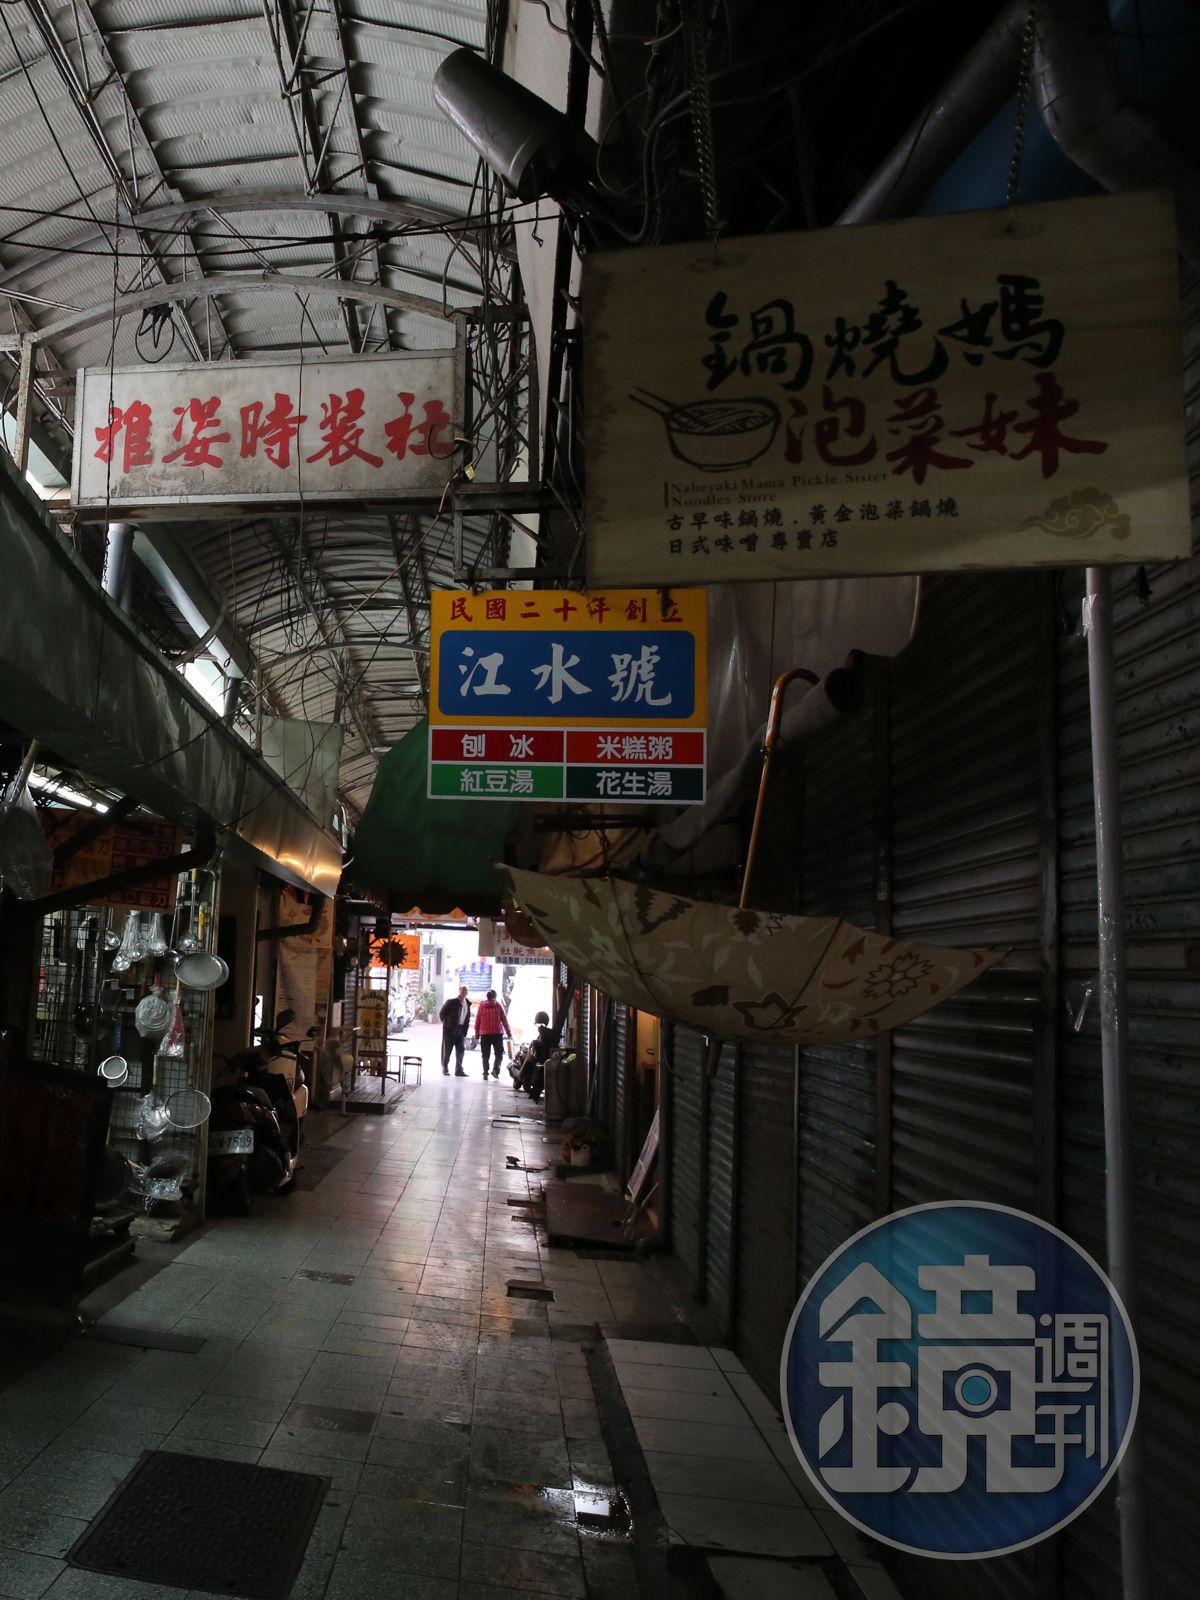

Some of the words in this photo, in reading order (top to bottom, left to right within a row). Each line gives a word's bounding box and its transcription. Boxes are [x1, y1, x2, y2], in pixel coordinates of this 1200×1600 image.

[701, 274, 1065, 391] 鍋燒媽
[783, 372, 1108, 485] 泡菜妹
[671, 481, 738, 496] Nabeyaki
[742, 478, 785, 489] Mama
[792, 473, 837, 487] Pickle
[845, 470, 888, 483] Sister
[671, 494, 732, 508] Noodles
[738, 491, 777, 504] Store
[668, 529, 838, 555] 日式味噌專賣店
[449, 597, 684, 623] 民國二十年創立
[457, 642, 673, 707] 江水號
[596, 735, 673, 761] 米糕粥
[460, 769, 534, 794] 紅豆湯
[596, 770, 673, 797] 花生湯
